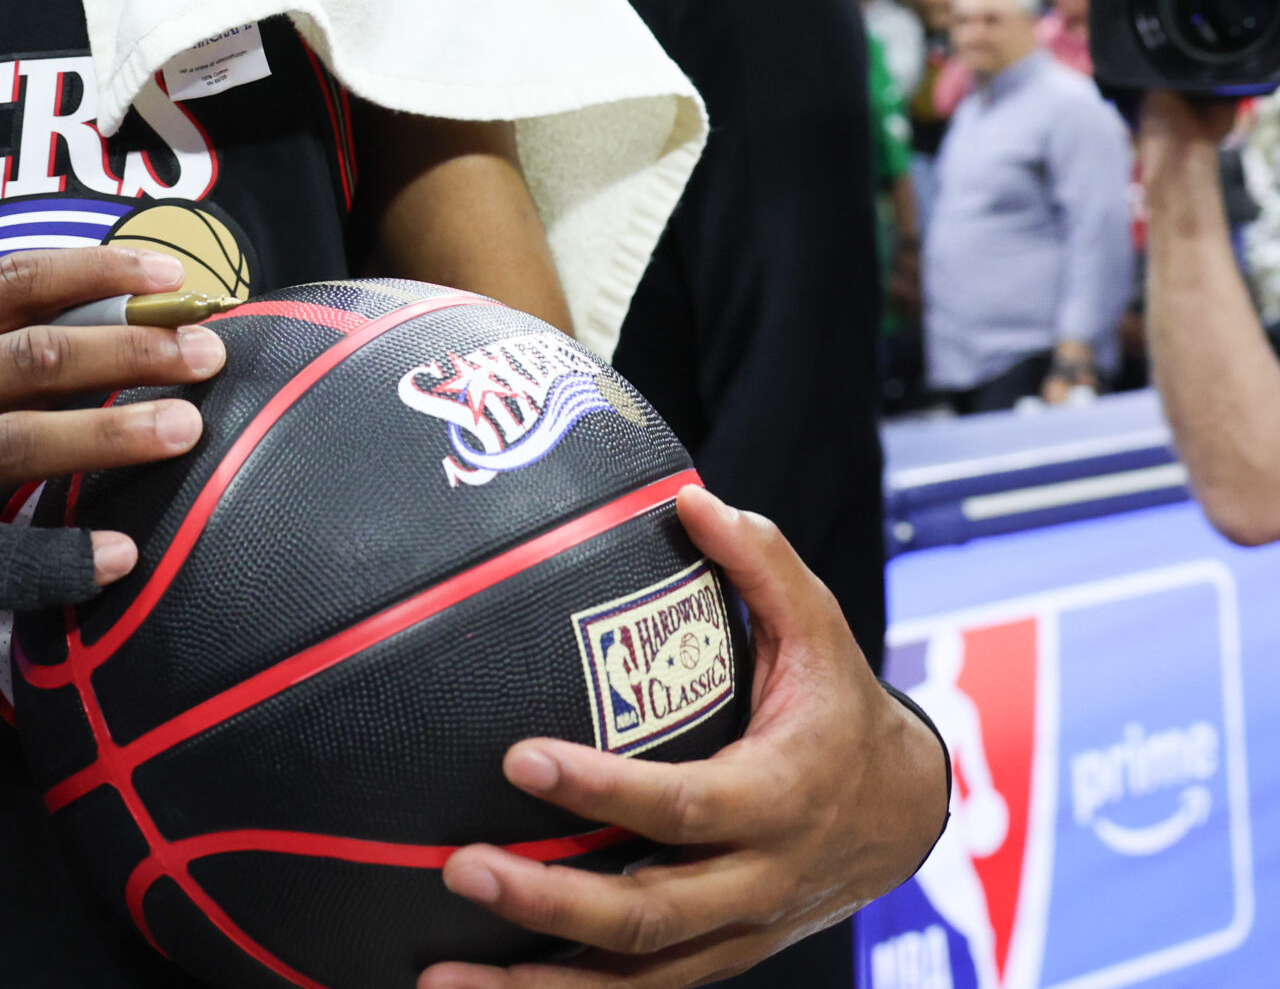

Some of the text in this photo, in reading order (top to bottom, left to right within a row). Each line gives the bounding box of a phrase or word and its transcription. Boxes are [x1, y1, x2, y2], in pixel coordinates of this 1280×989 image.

[635, 585, 721, 676] HARDWOOD
[648, 638, 728, 720] CLASSICS
[1070, 720, 1219, 826] prime
